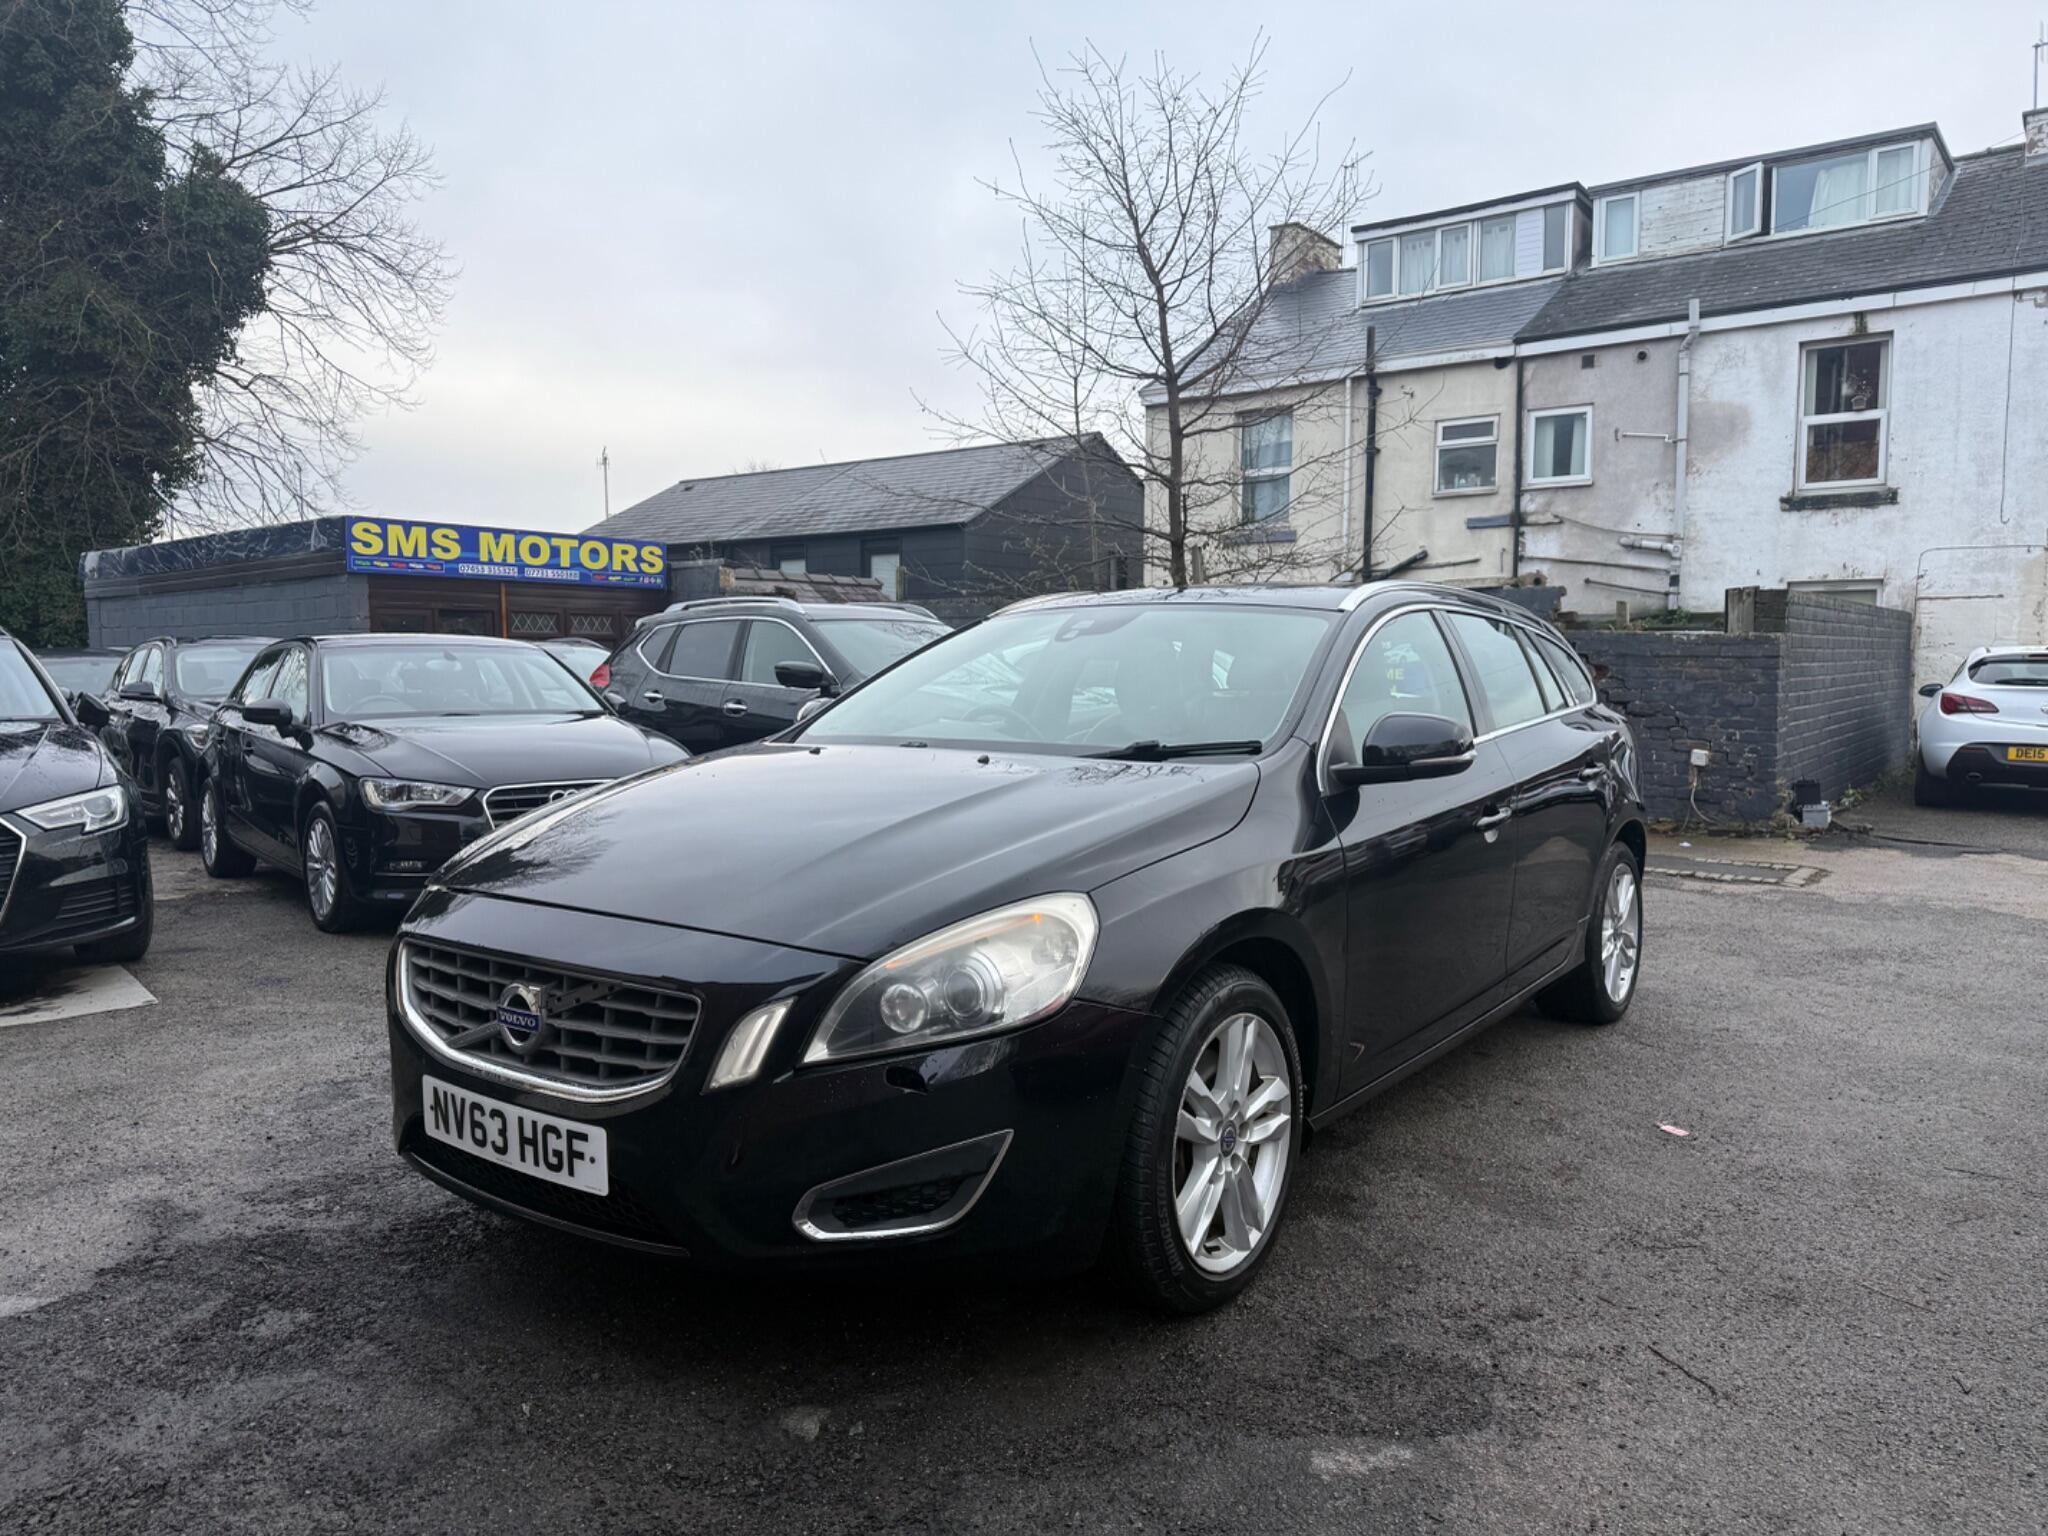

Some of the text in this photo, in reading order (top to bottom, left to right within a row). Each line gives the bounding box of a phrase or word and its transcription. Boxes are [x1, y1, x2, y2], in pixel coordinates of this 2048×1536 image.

[351, 521, 664, 574] SMS MOTORS
[2016, 747, 2045, 759] DE15
[499, 1010, 536, 1027] VOLVO
[433, 1086, 589, 1177] NV63 HGF
